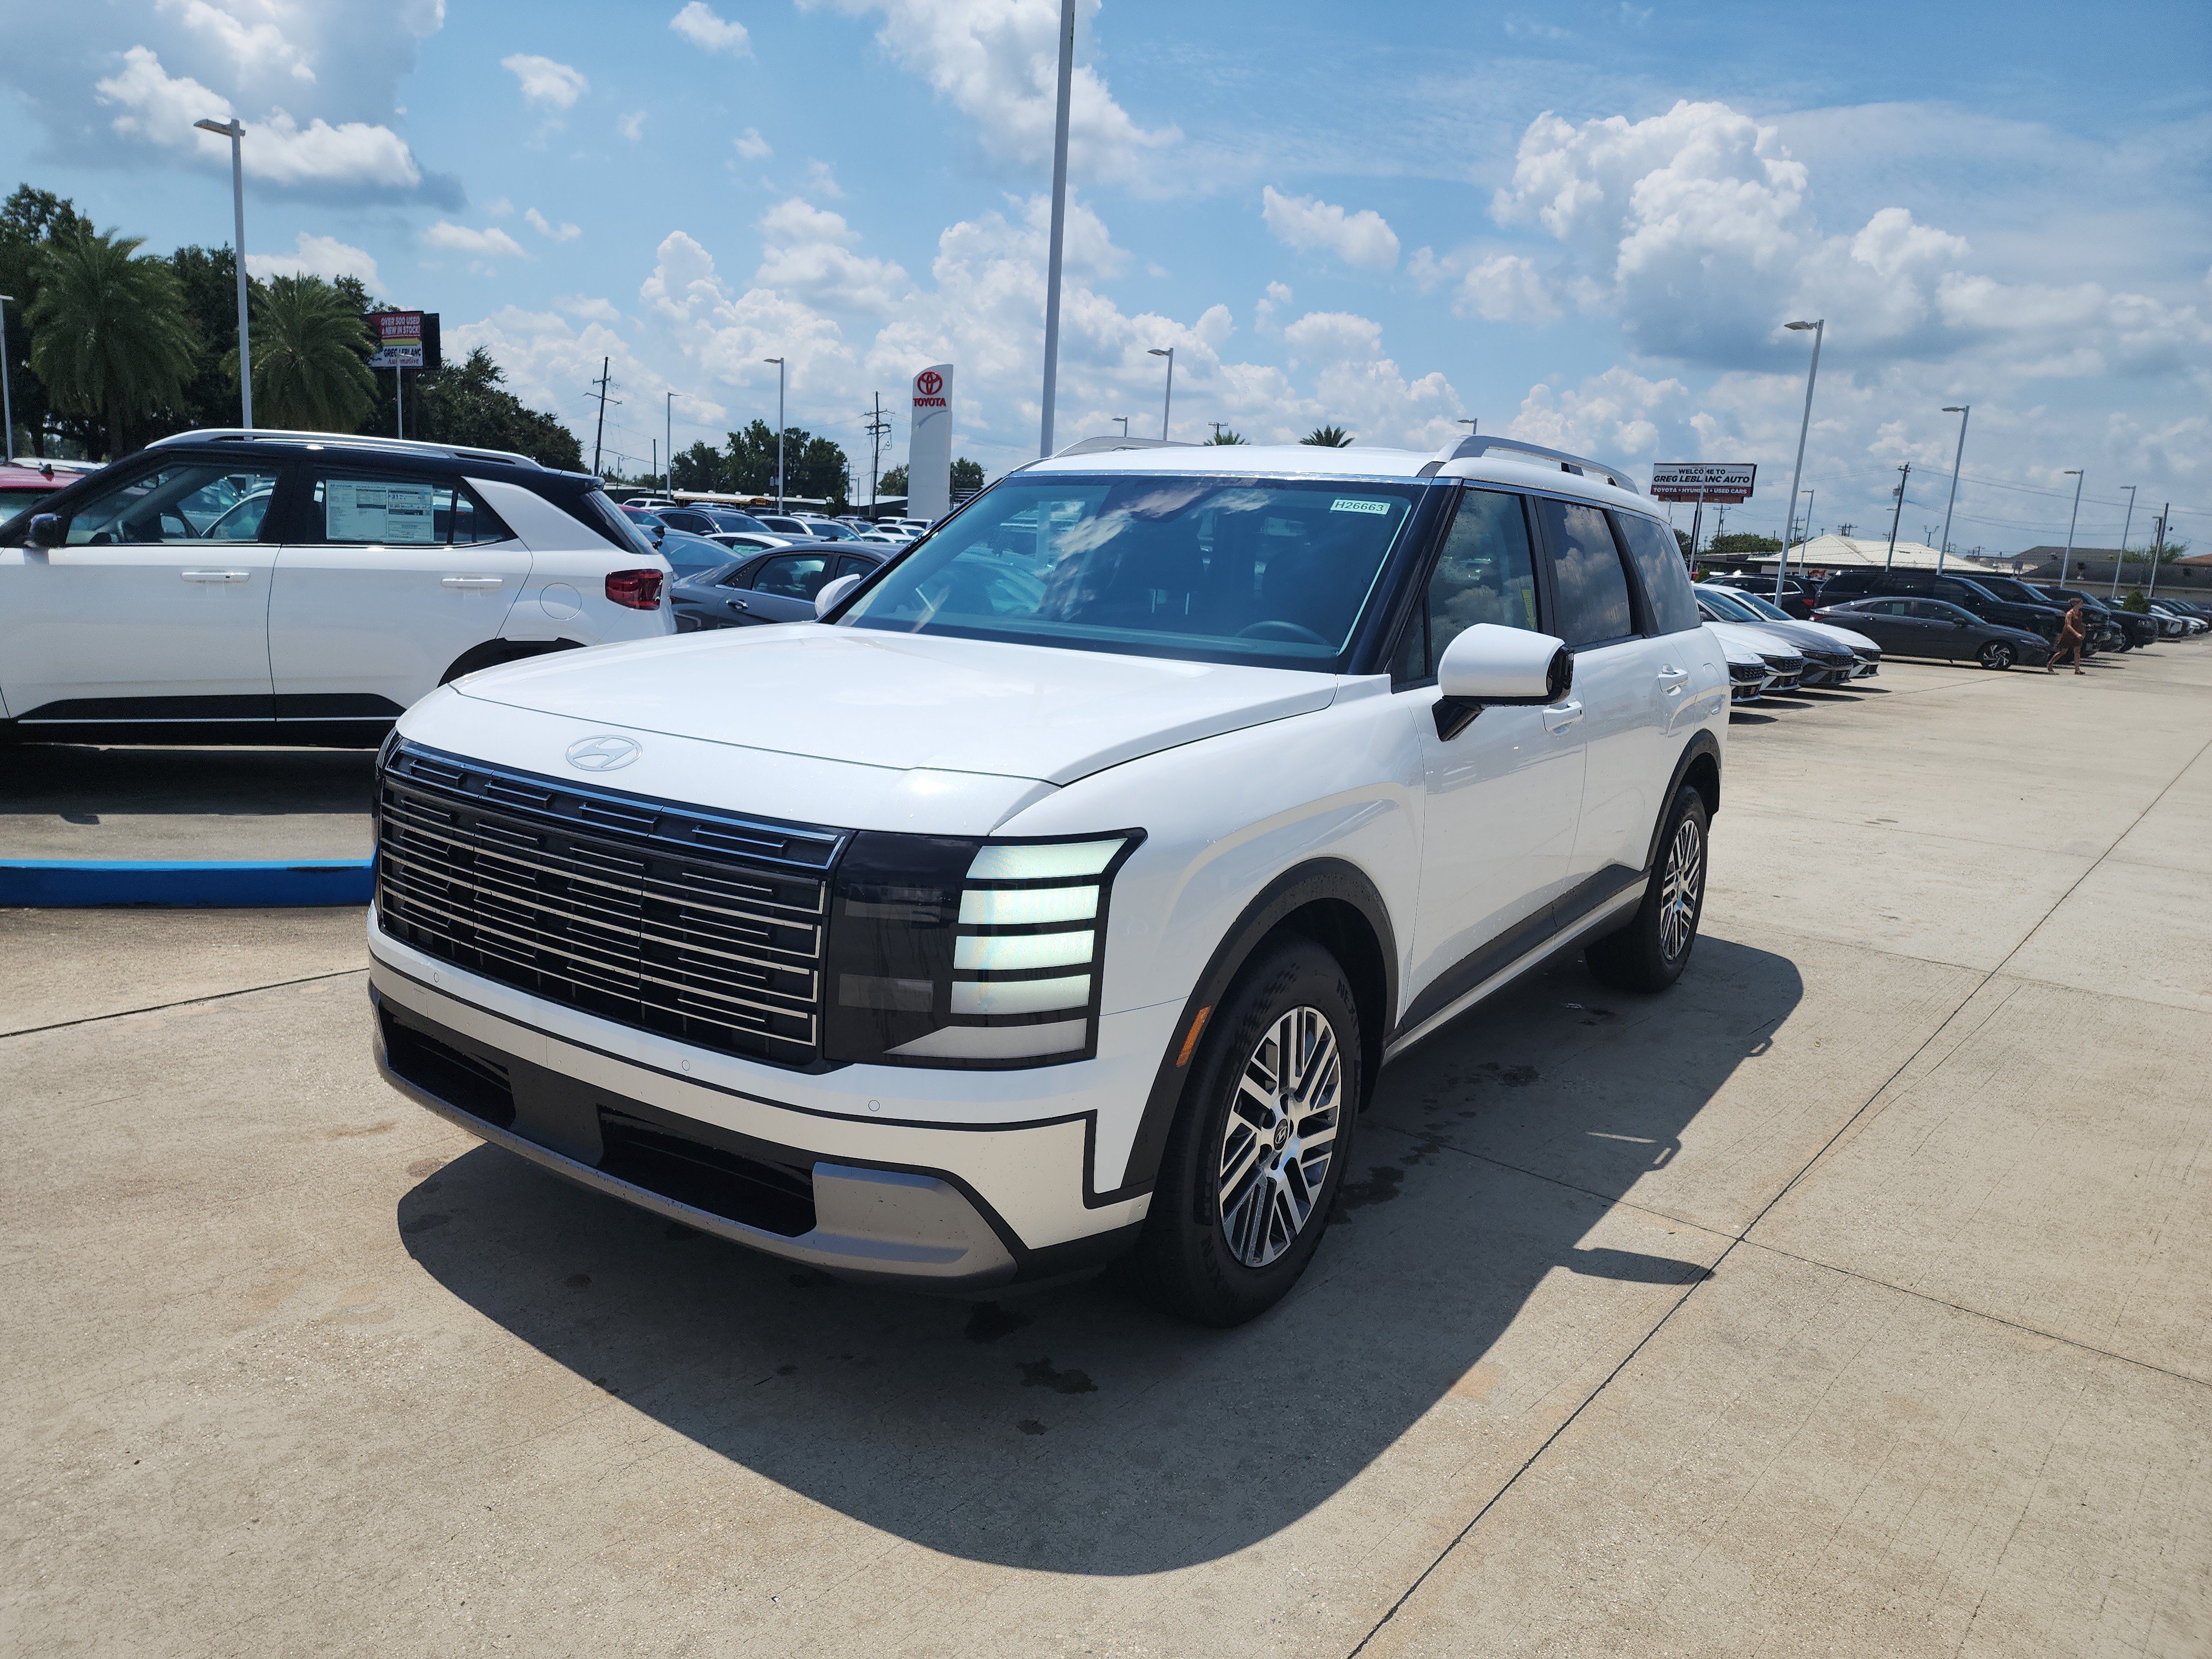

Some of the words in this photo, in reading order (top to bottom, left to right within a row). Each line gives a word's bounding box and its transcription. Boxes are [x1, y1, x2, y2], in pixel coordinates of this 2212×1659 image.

[406, 316, 420, 324] USED
[913, 398, 946, 406] TOYOTA
[1335, 502, 1384, 511] H26663
